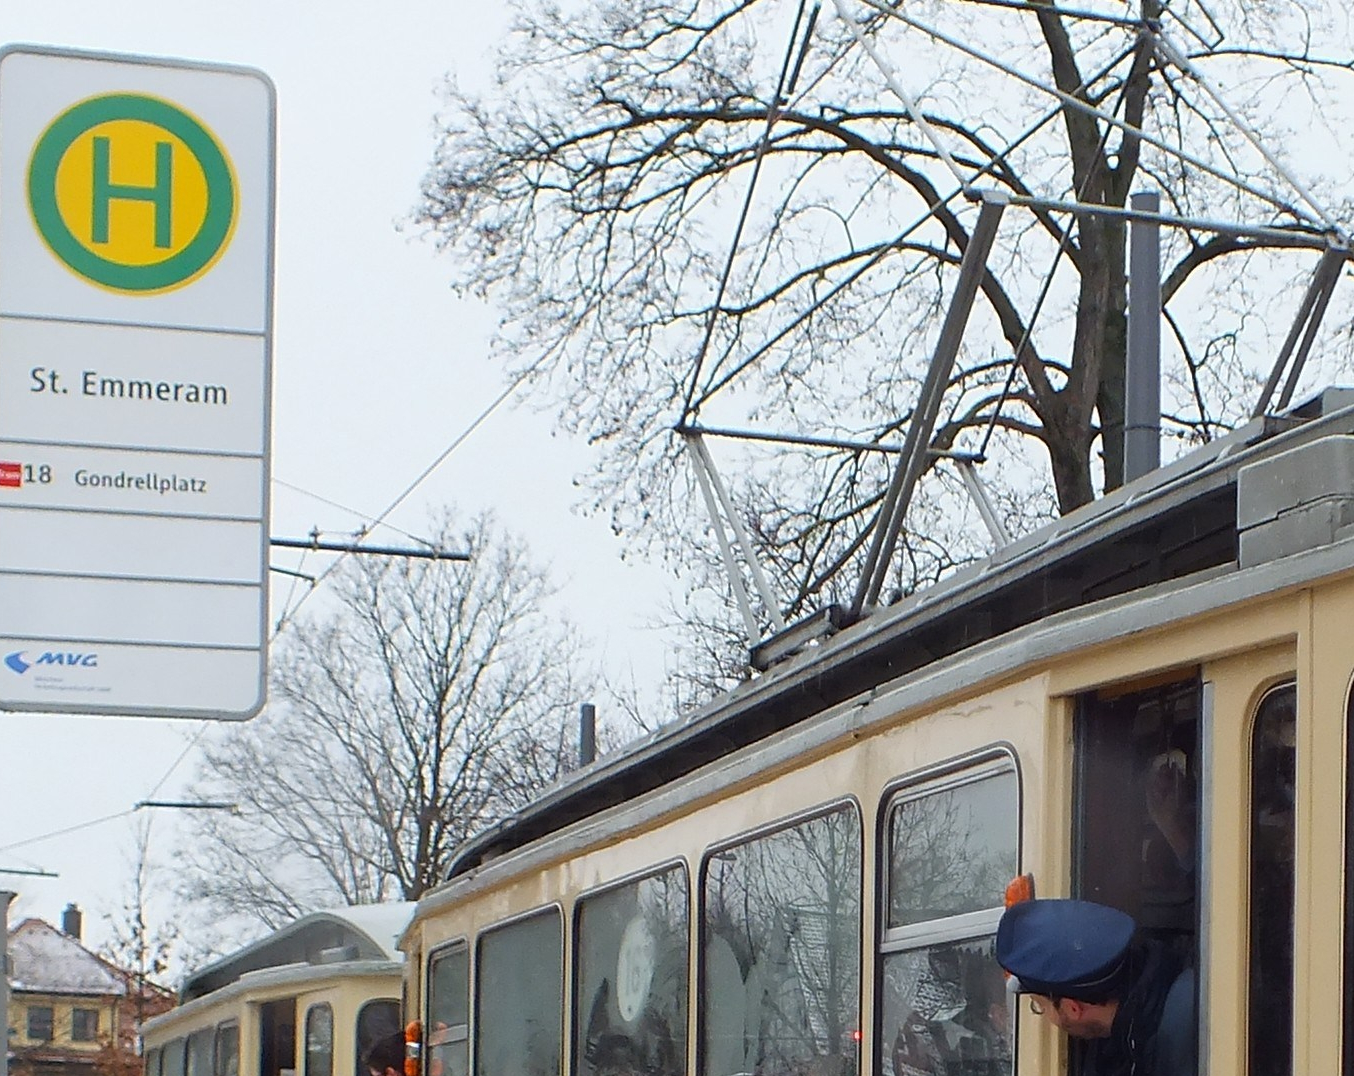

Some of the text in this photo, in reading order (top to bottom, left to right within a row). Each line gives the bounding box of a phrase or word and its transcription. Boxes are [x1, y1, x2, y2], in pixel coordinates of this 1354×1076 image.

[91, 136, 173, 249] H
[31, 367, 229, 405] St. Emmeram
[24, 464, 52, 483] 18
[75, 469, 208, 494] Gondrellplatz
[36, 651, 98, 667] MVG
